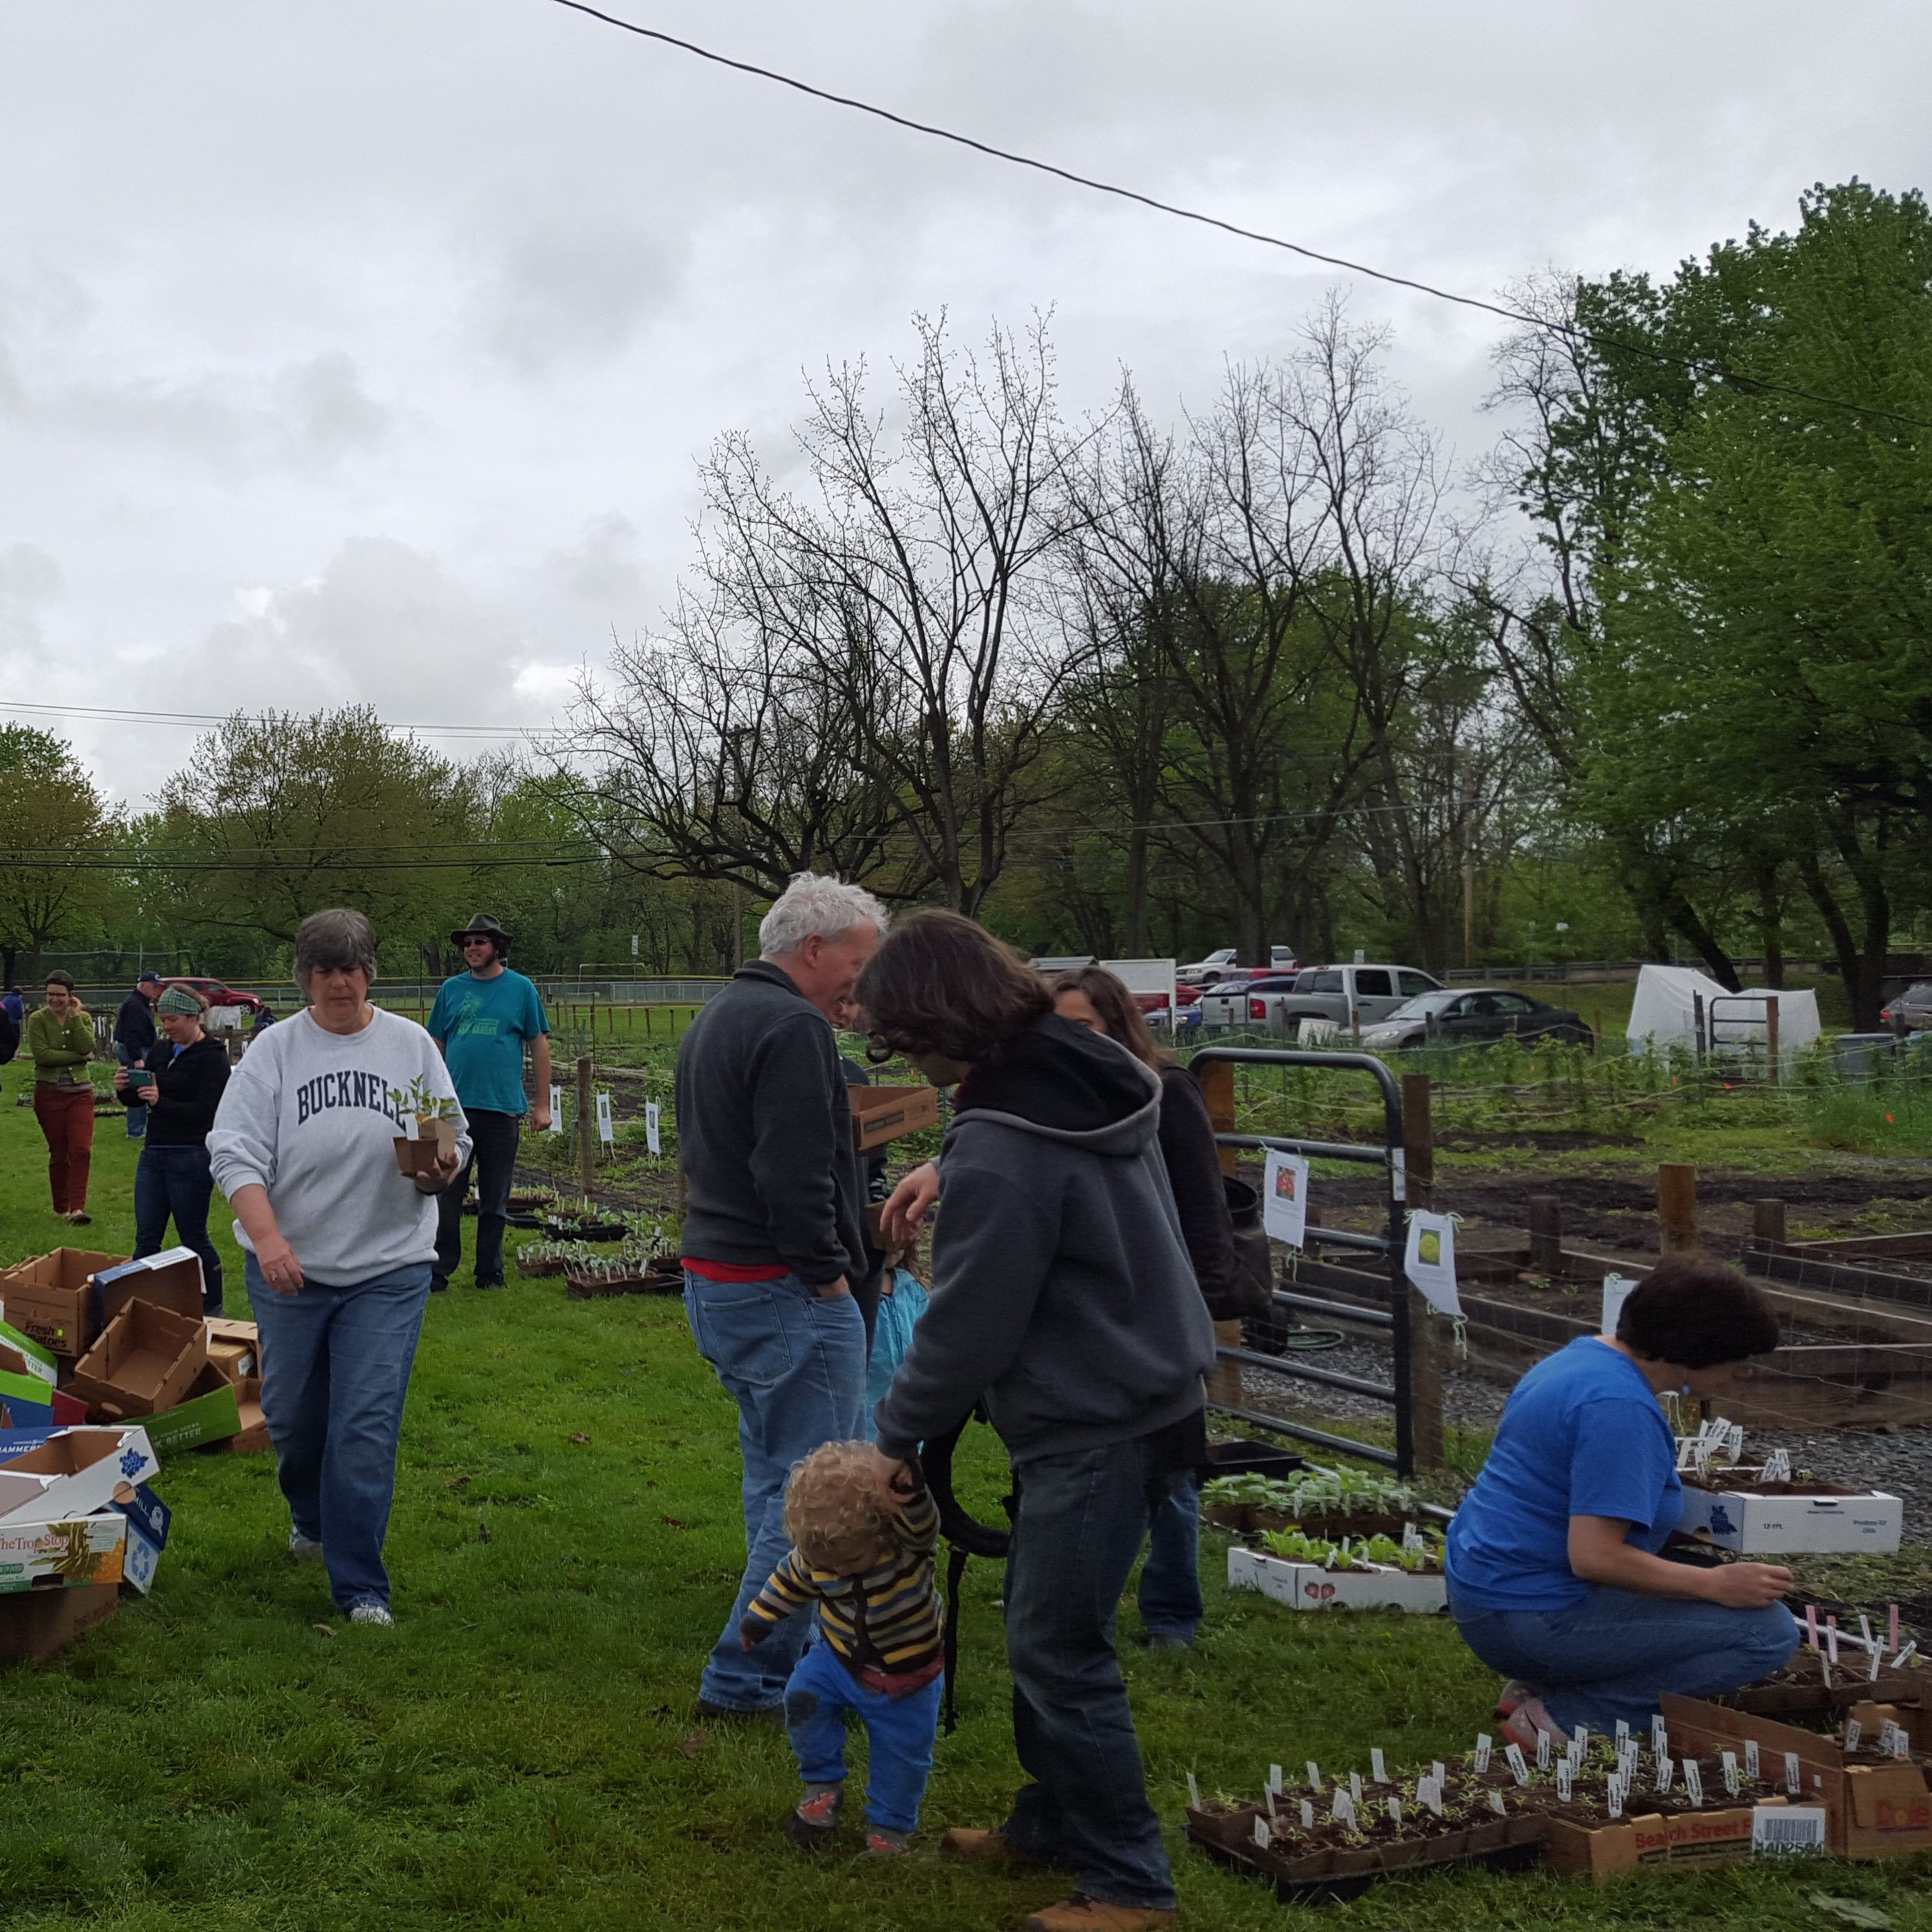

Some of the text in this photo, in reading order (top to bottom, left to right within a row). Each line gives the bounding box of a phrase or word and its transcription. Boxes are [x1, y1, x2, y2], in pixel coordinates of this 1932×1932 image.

[25, 1322, 55, 1336] Fresh
[166, 1426, 202, 1445] BETTER
[43, 1534, 70, 1553] Stop
[1691, 1818, 1739, 1840] Street
